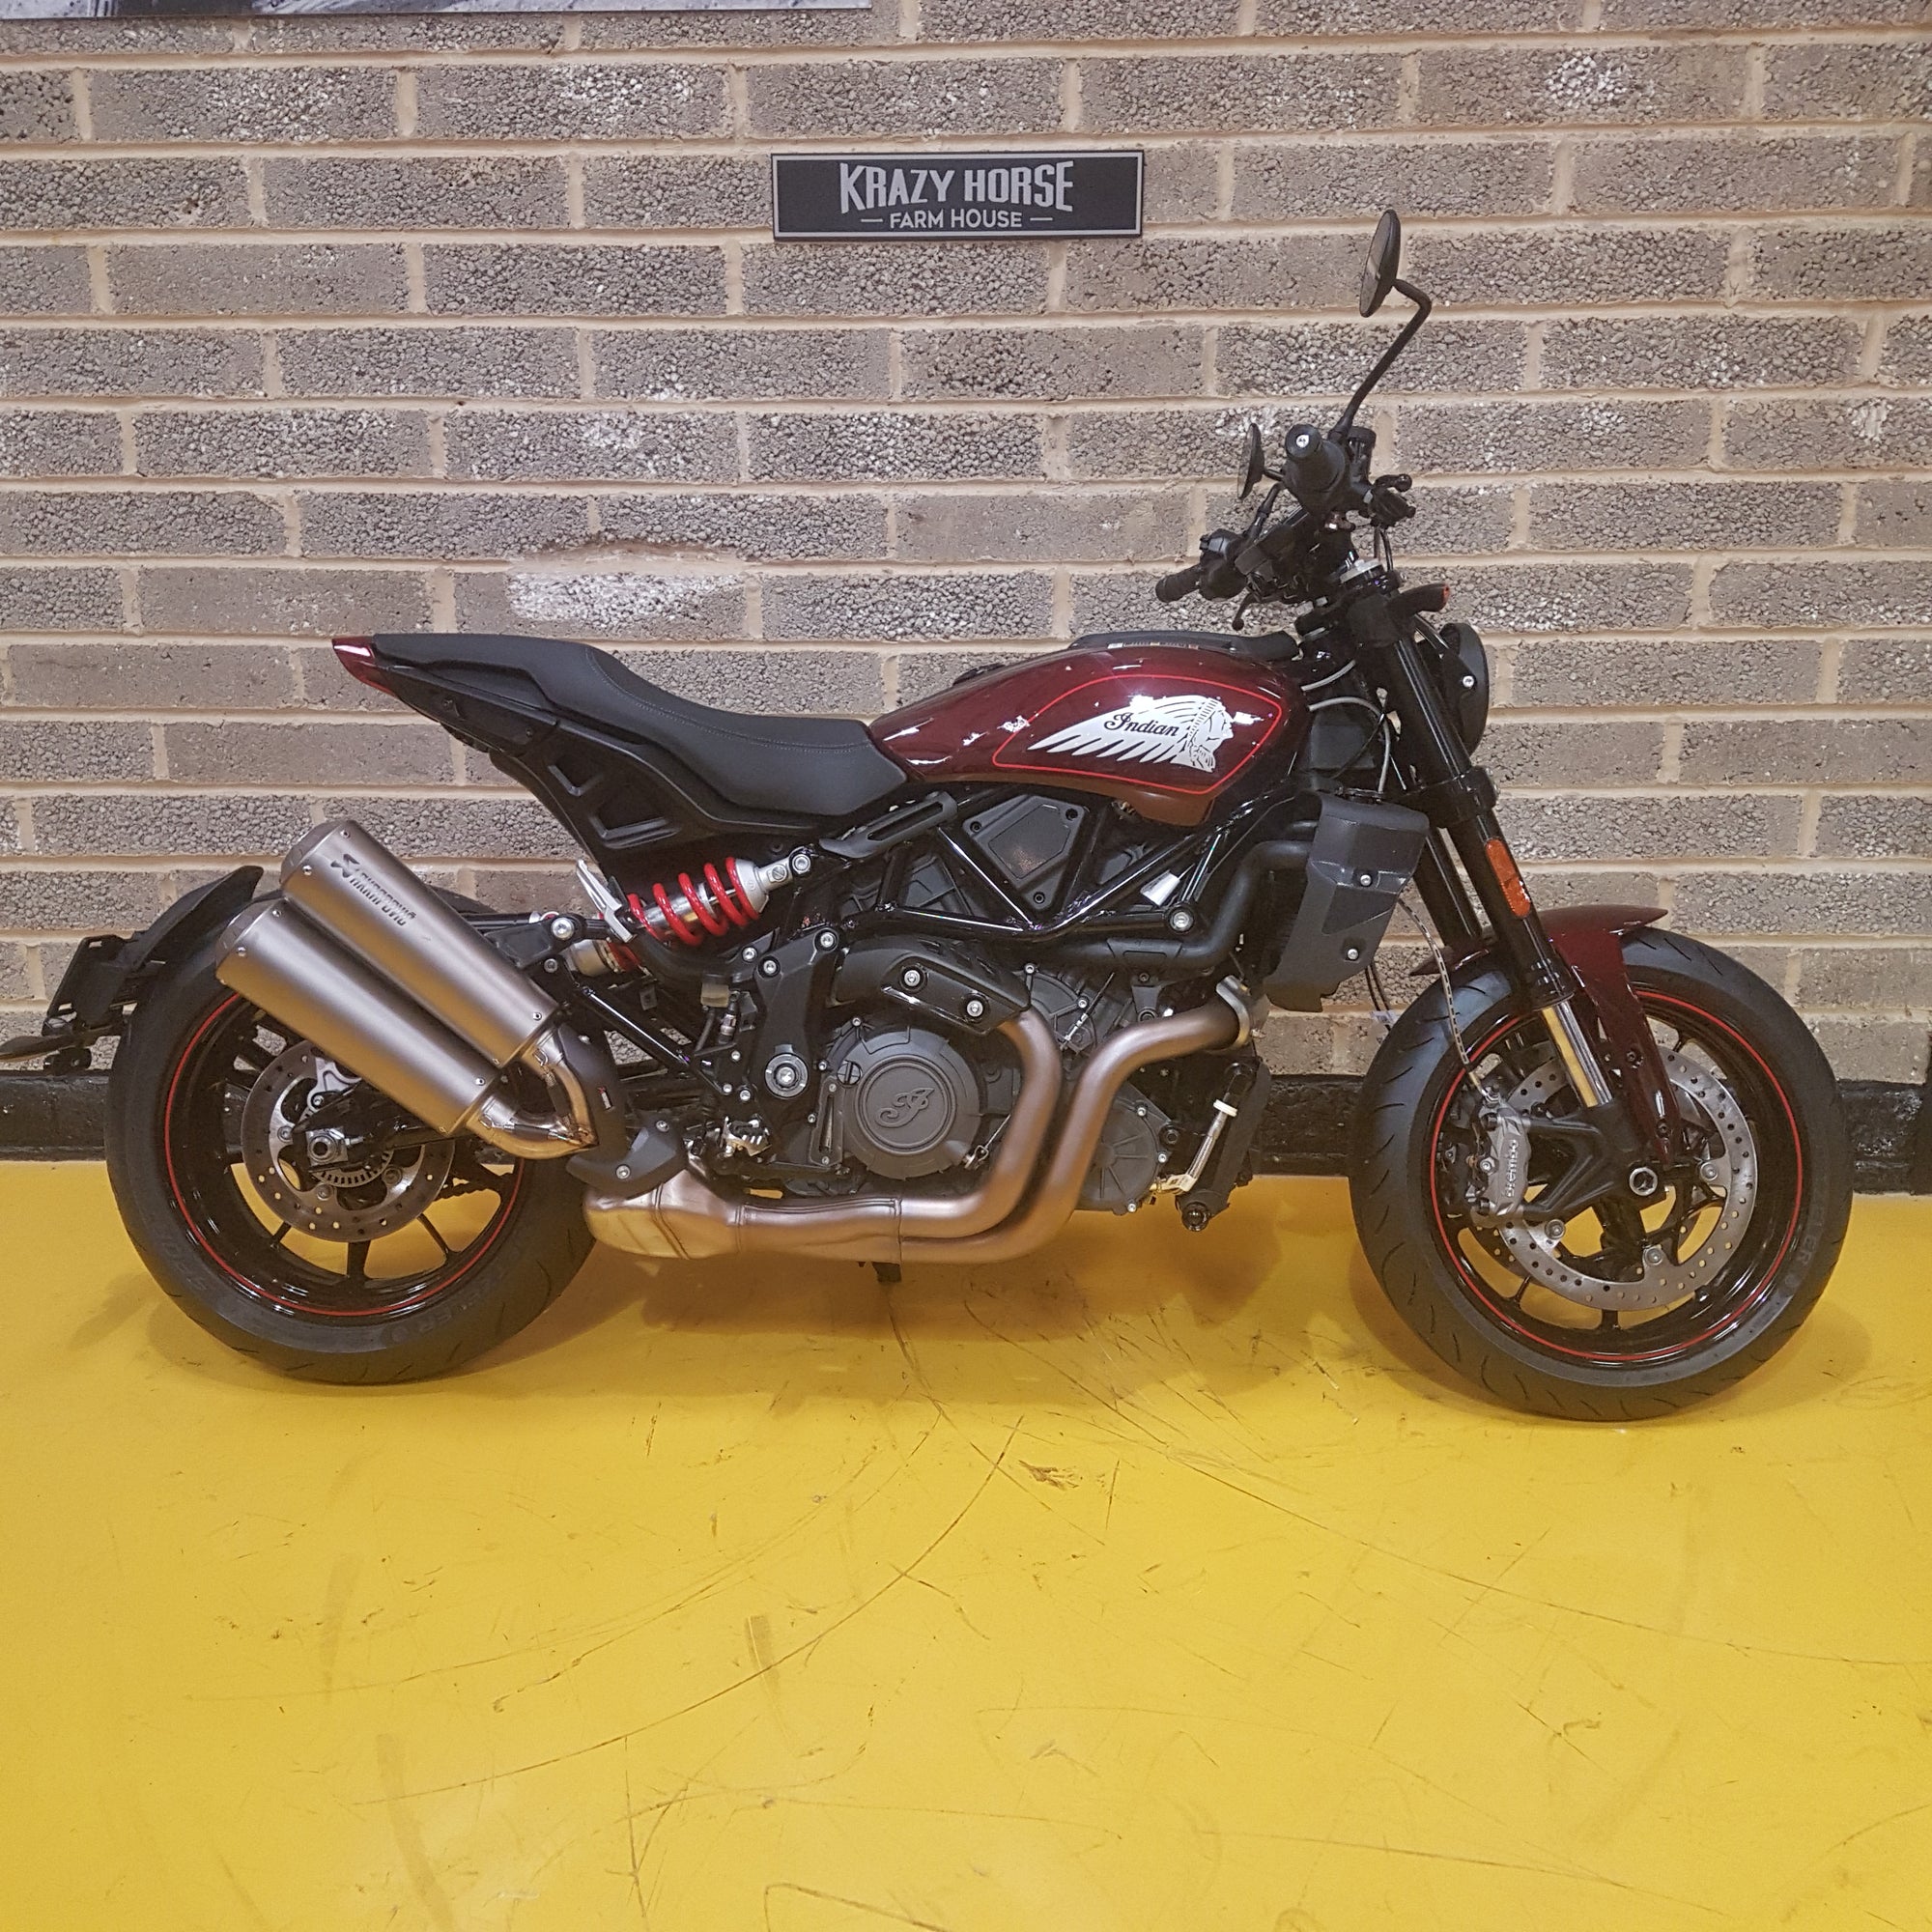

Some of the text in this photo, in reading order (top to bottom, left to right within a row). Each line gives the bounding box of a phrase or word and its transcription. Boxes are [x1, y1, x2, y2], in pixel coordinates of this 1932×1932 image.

[838, 160, 1074, 213] KRAZY HORSE
[890, 208, 1023, 229] FARM HOUSE
[1103, 712, 1179, 738] Indian
